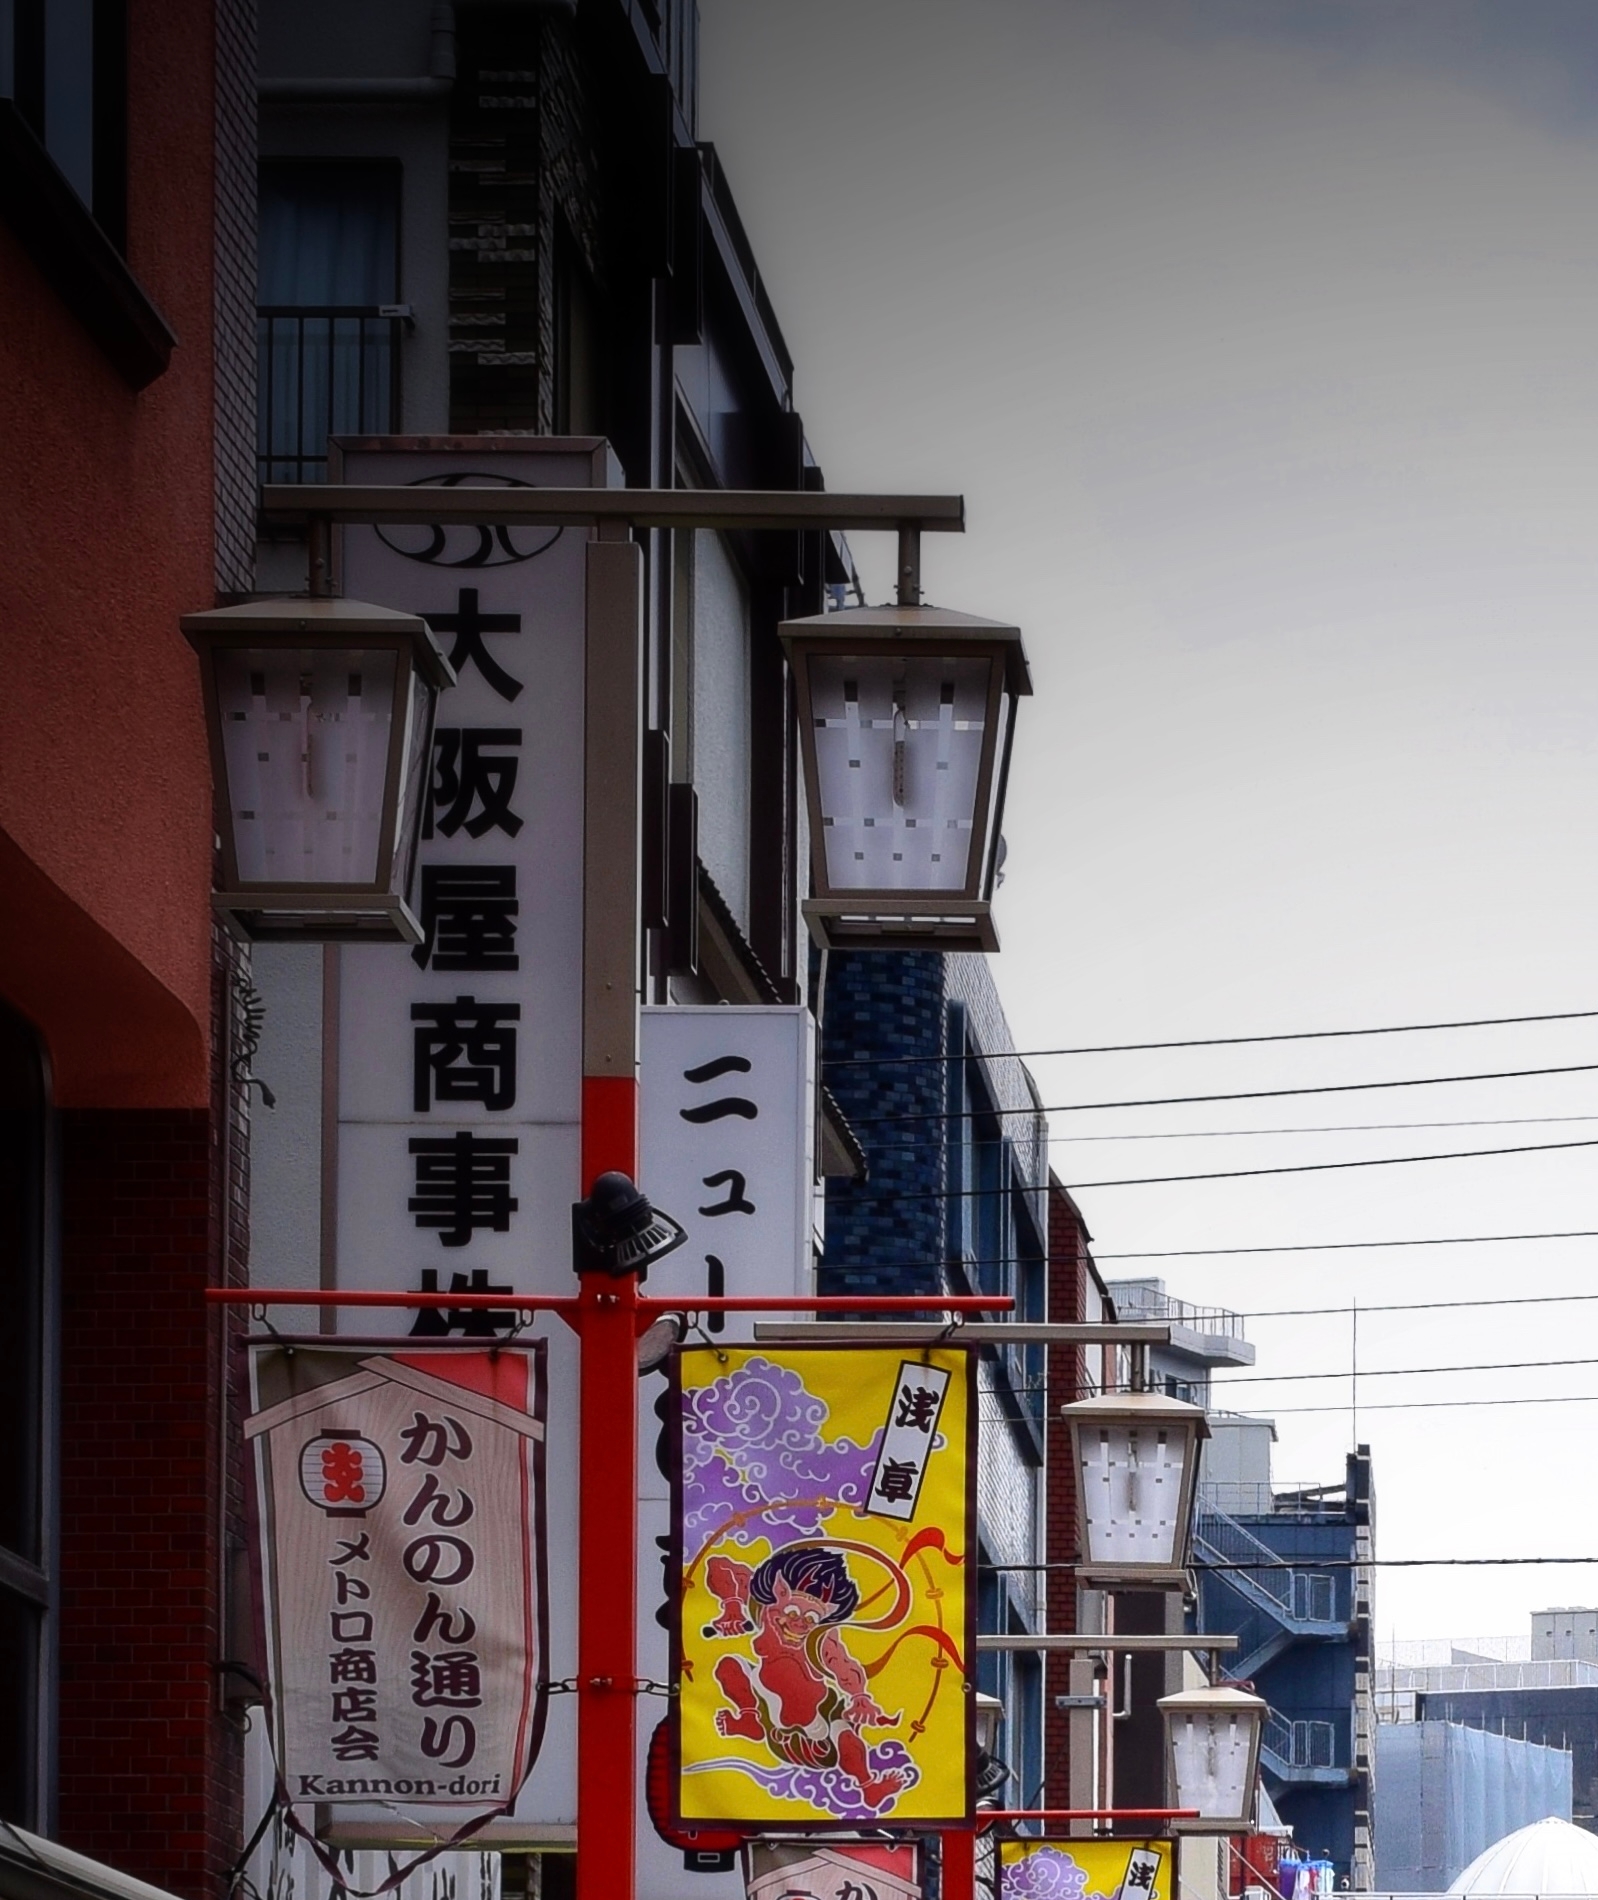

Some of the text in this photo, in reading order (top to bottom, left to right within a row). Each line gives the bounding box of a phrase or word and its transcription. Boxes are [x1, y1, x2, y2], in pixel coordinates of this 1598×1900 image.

[875, 1387, 939, 1503] 浅草
[328, 1533, 378, 1762] メトロ商店会
[400, 1411, 481, 1769] かんのん通り
[299, 1774, 501, 1797] Kannon-dori
